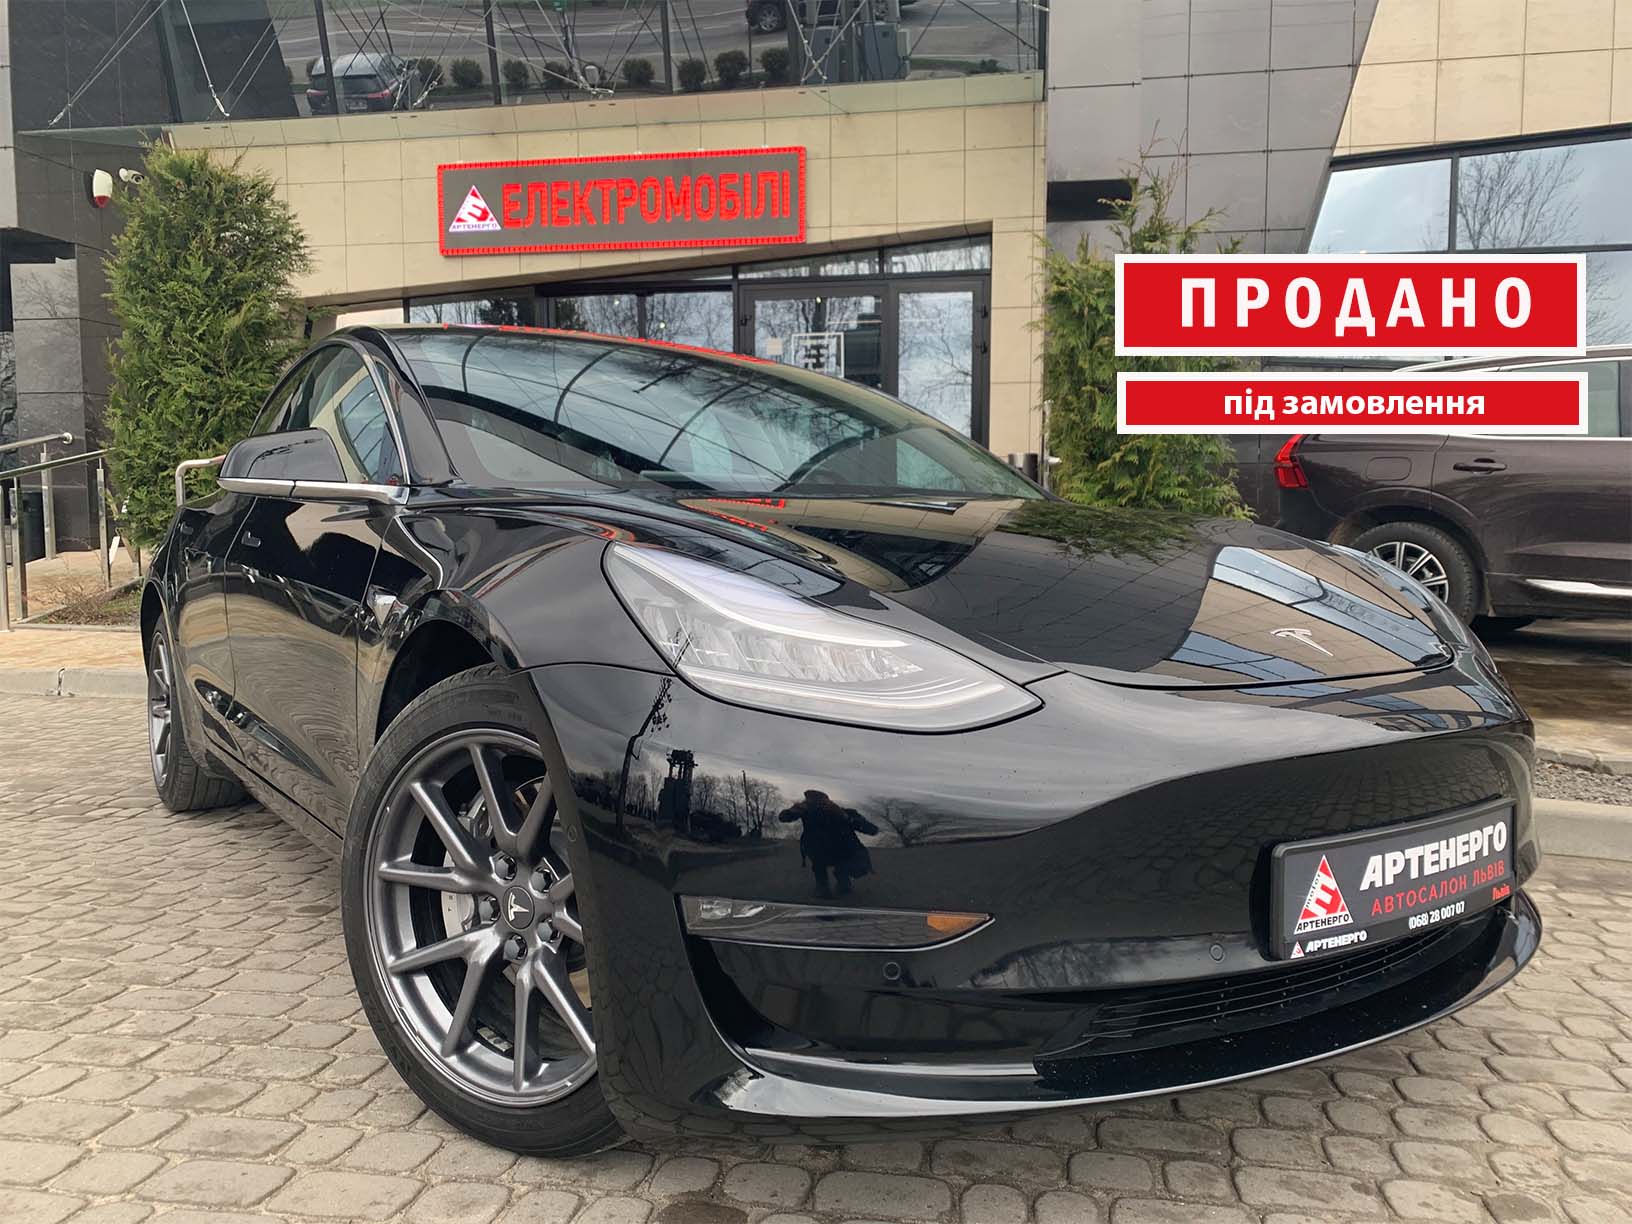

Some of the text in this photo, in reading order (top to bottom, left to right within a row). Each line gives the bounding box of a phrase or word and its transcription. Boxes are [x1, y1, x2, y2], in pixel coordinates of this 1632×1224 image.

[502, 170, 791, 229] ЕЛЕКТРОМОБІЛІ
[1360, 821, 1507, 891] АРТЕНЕРГО
[1371, 874, 1467, 917] АВТОСАЛОН
[1296, 914, 1350, 932] АРТЕНЕРГО
[1408, 900, 1465, 930] (068) 28 007 07
[1305, 930, 1368, 953] АРТЕНЕРГО
